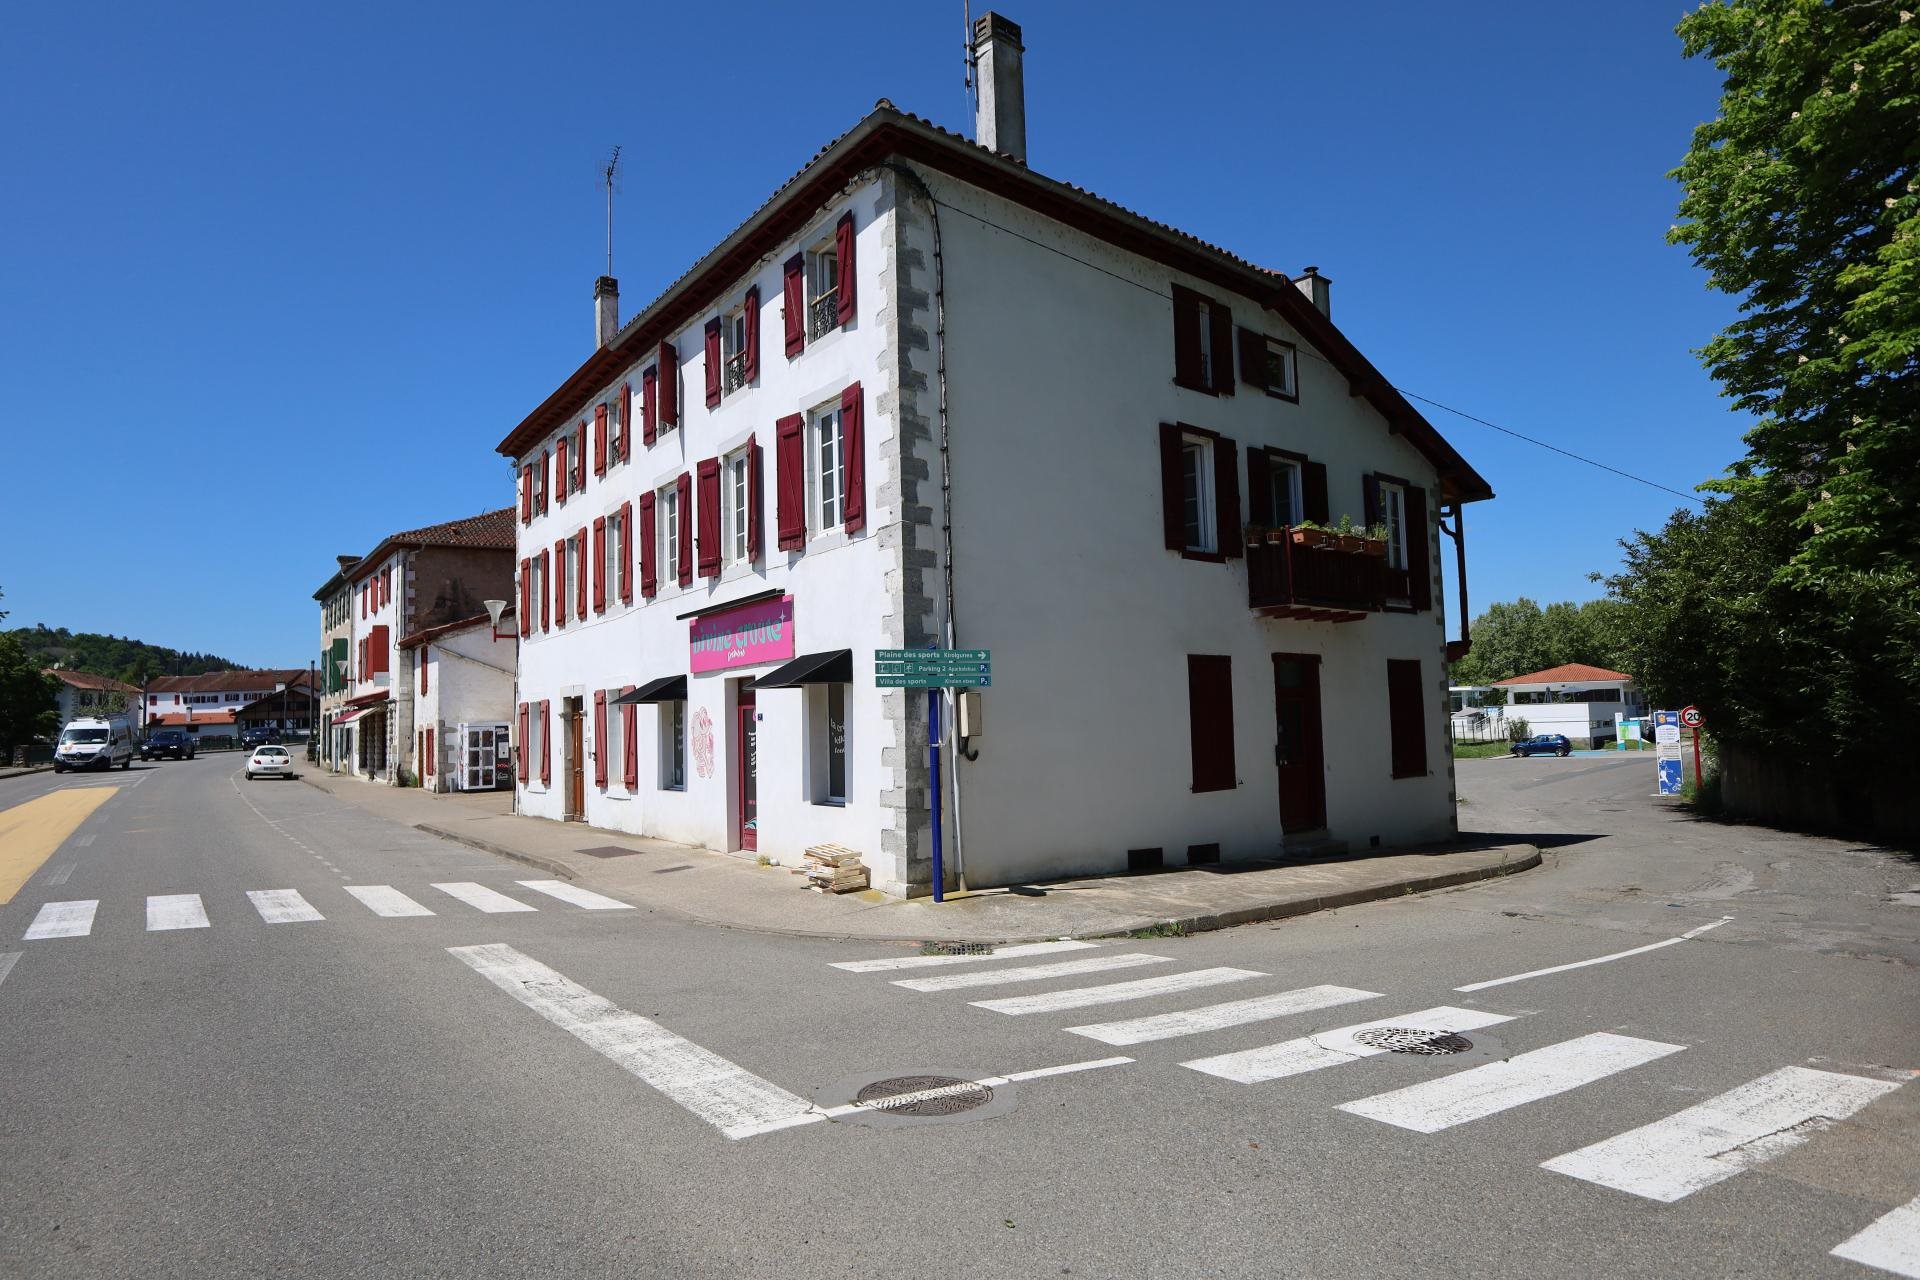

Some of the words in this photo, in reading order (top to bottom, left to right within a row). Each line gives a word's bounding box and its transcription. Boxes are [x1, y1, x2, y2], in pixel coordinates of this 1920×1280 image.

[918, 651, 940, 660] sports
[918, 665, 941, 673] Parking
[907, 678, 927, 686] sports
[1687, 712, 1700, 721] 20
